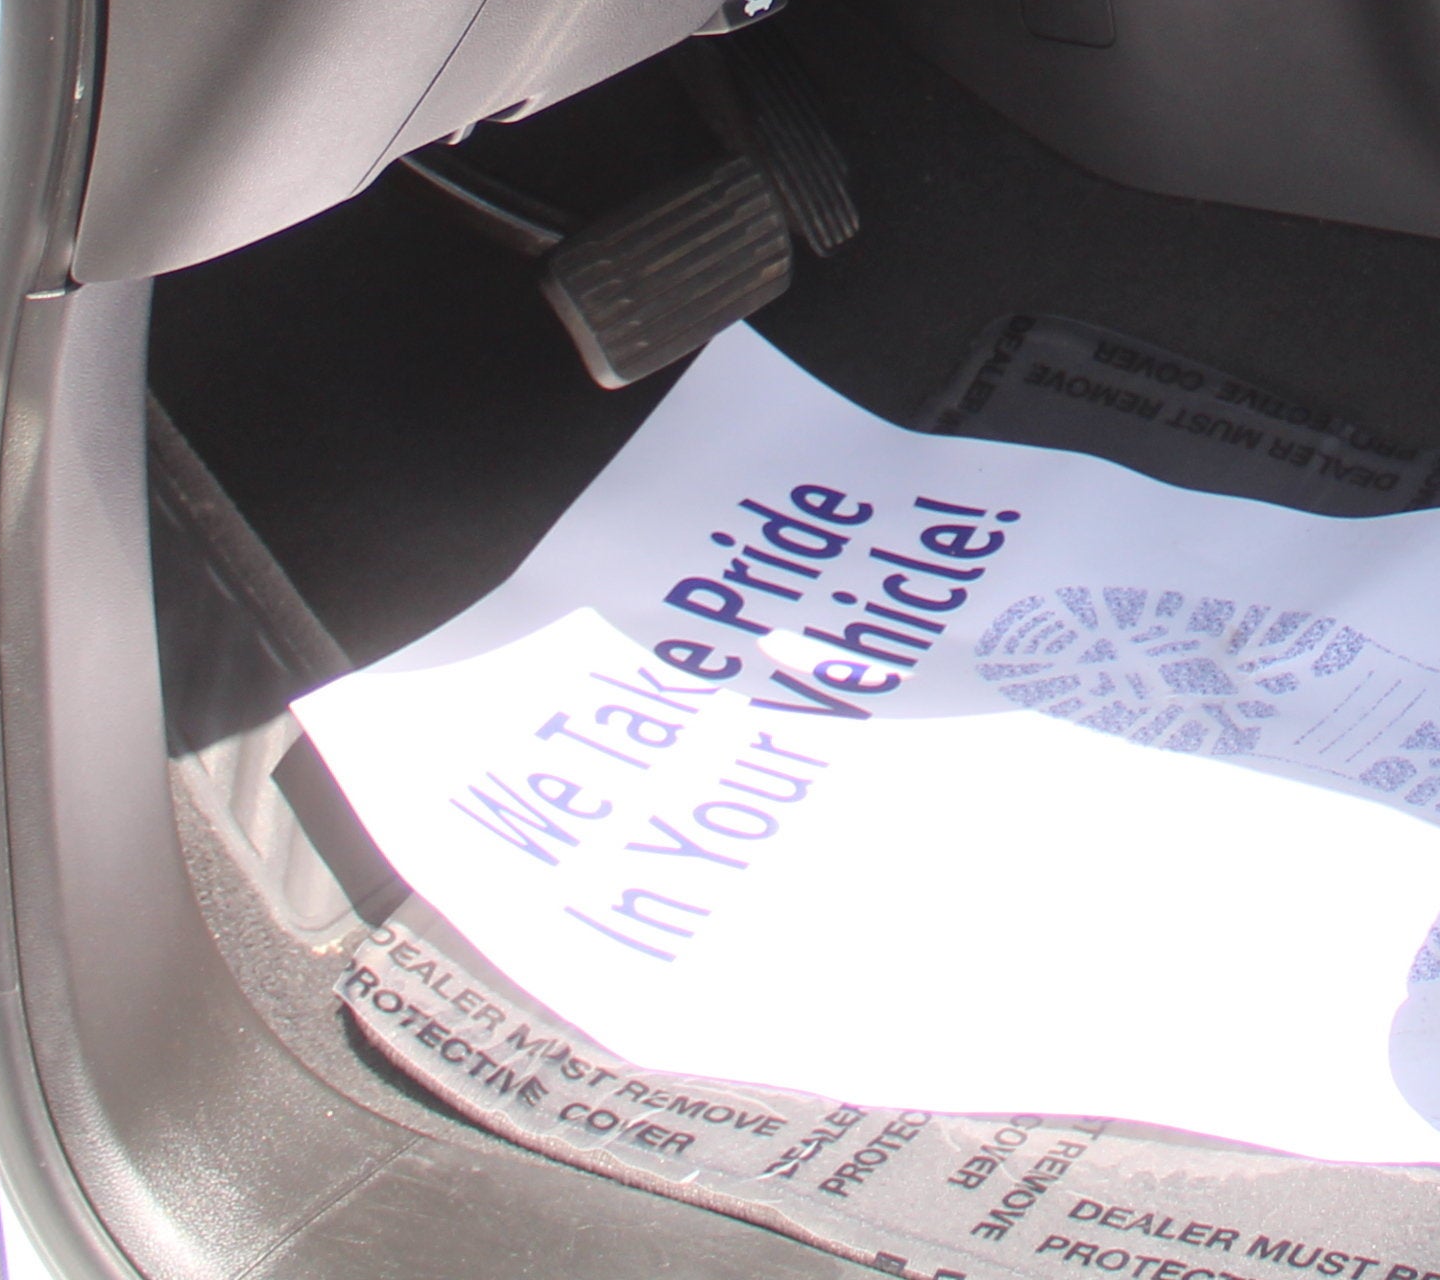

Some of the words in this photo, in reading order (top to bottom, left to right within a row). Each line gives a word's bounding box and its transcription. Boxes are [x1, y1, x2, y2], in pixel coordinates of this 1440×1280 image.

[1023, 360, 1164, 421] REMOVE
[1092, 339, 1205, 392] COVER
[1165, 406, 1263, 451] MUST
[1216, 379, 1420, 463] PROECTIVE
[1267, 437, 1400, 492] DEALER
[749, 495, 1021, 721] Vehicle!
[450, 772, 614, 866] We
[535, 638, 744, 771] Take
[663, 483, 874, 636] Pride
[623, 731, 830, 871] Your
[564, 887, 712, 963] In
[366, 925, 507, 1032] DEALER
[505, 1022, 618, 1088] MUST
[613, 1078, 789, 1139] REMOVE
[559, 1101, 696, 1155] COVER
[763, 1103, 868, 1178] DEALE
[947, 1114, 1044, 1191] COVER
[970, 1139, 1088, 1241] REMOVE
[1035, 1235, 1260, 1280] PROTE
[1068, 1199, 1240, 1252] DEALER
[1246, 1235, 1380, 1280] MUST
